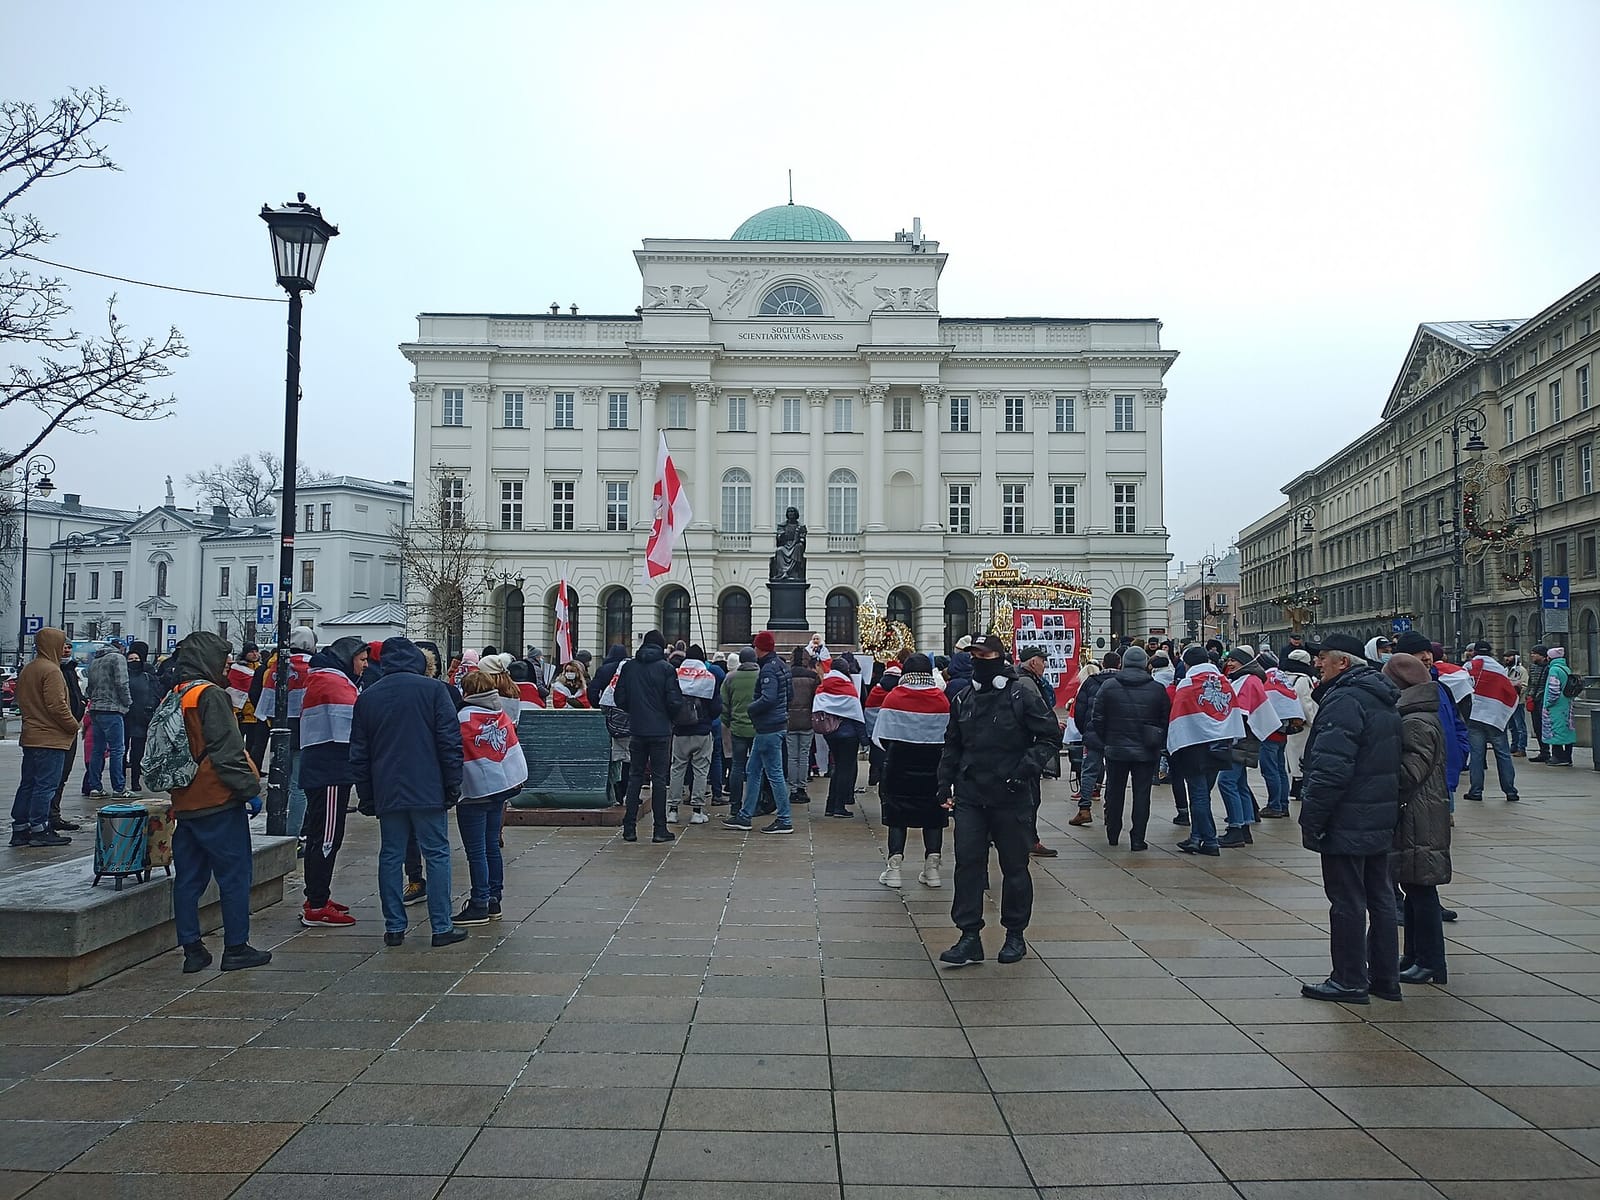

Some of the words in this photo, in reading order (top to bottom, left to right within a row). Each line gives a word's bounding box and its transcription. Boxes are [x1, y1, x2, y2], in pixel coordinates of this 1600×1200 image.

[995, 556, 1006, 567] 18
[261, 585, 270, 596] P
[261, 607, 270, 618] P
[27, 619, 39, 633] P
